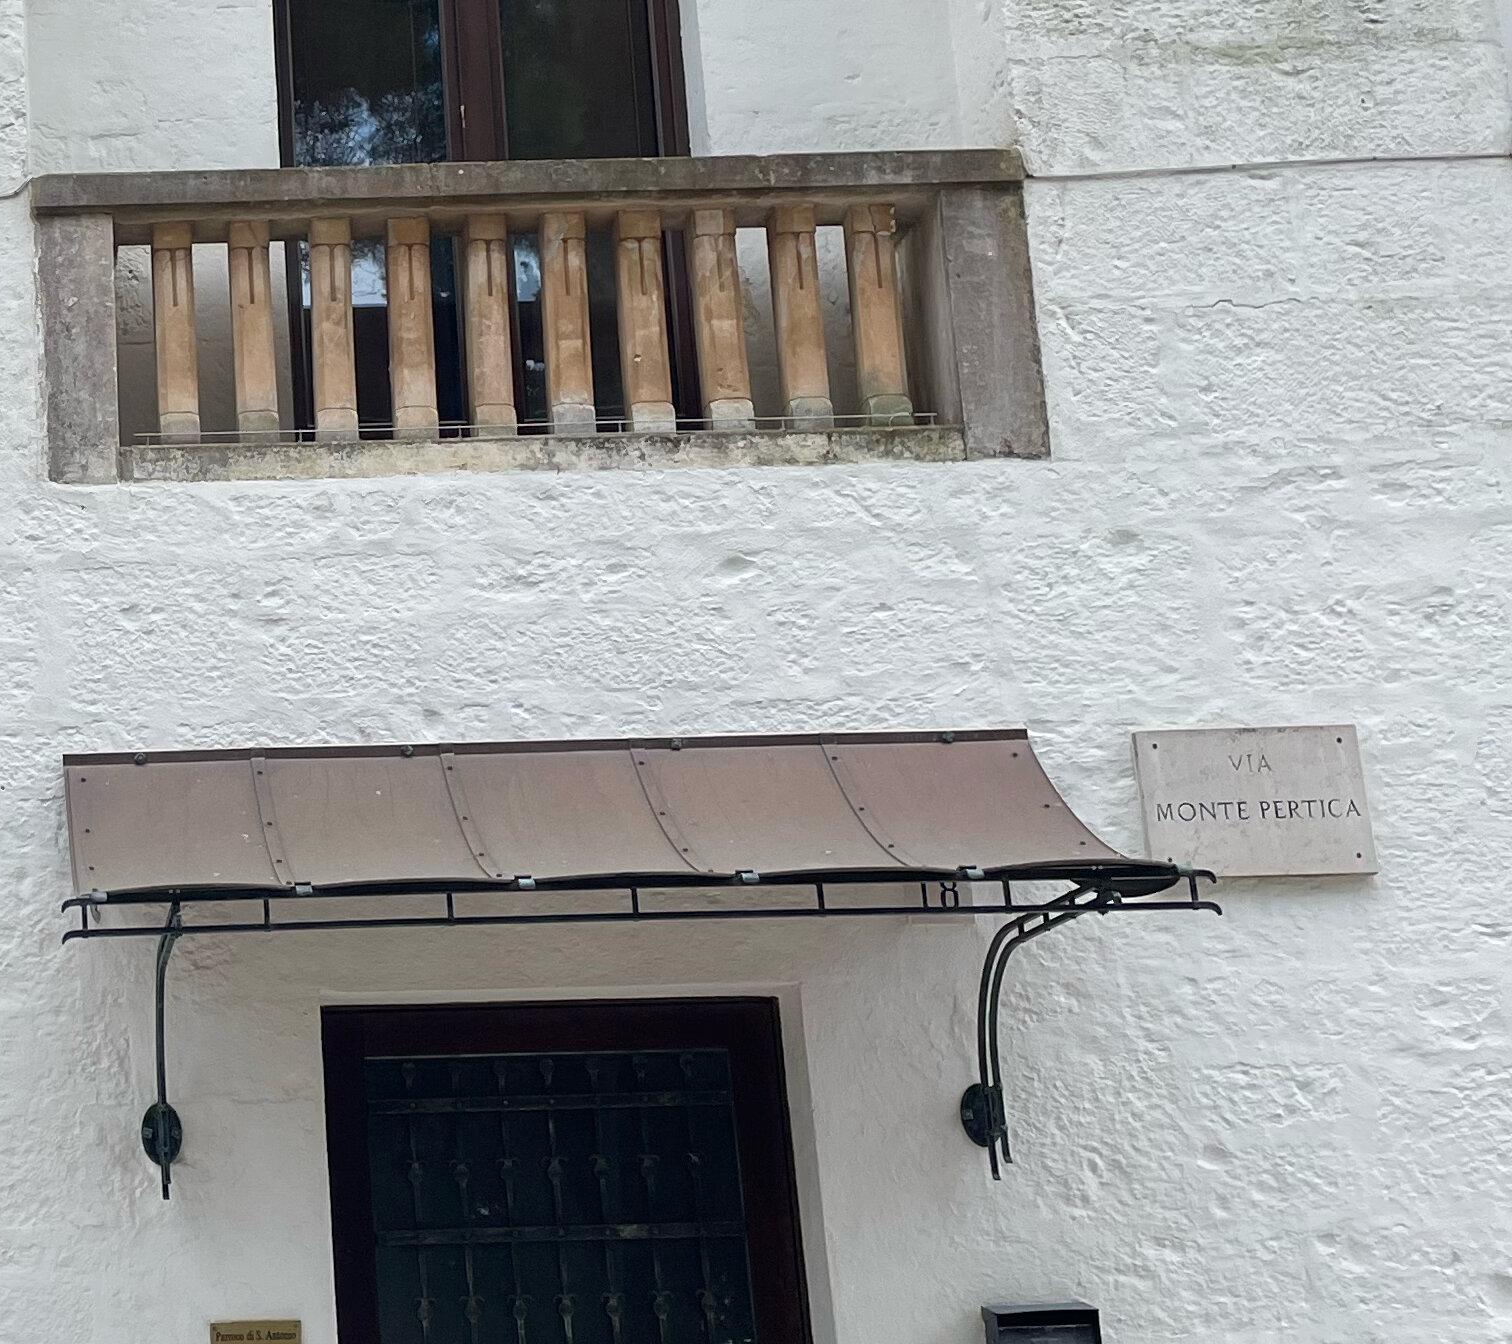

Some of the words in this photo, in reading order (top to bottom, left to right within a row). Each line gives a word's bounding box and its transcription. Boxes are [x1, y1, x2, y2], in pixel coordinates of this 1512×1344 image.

[1228, 753, 1272, 773] VIA
[1156, 801, 1250, 822] MONTE
[1259, 799, 1361, 819] PERTICA
